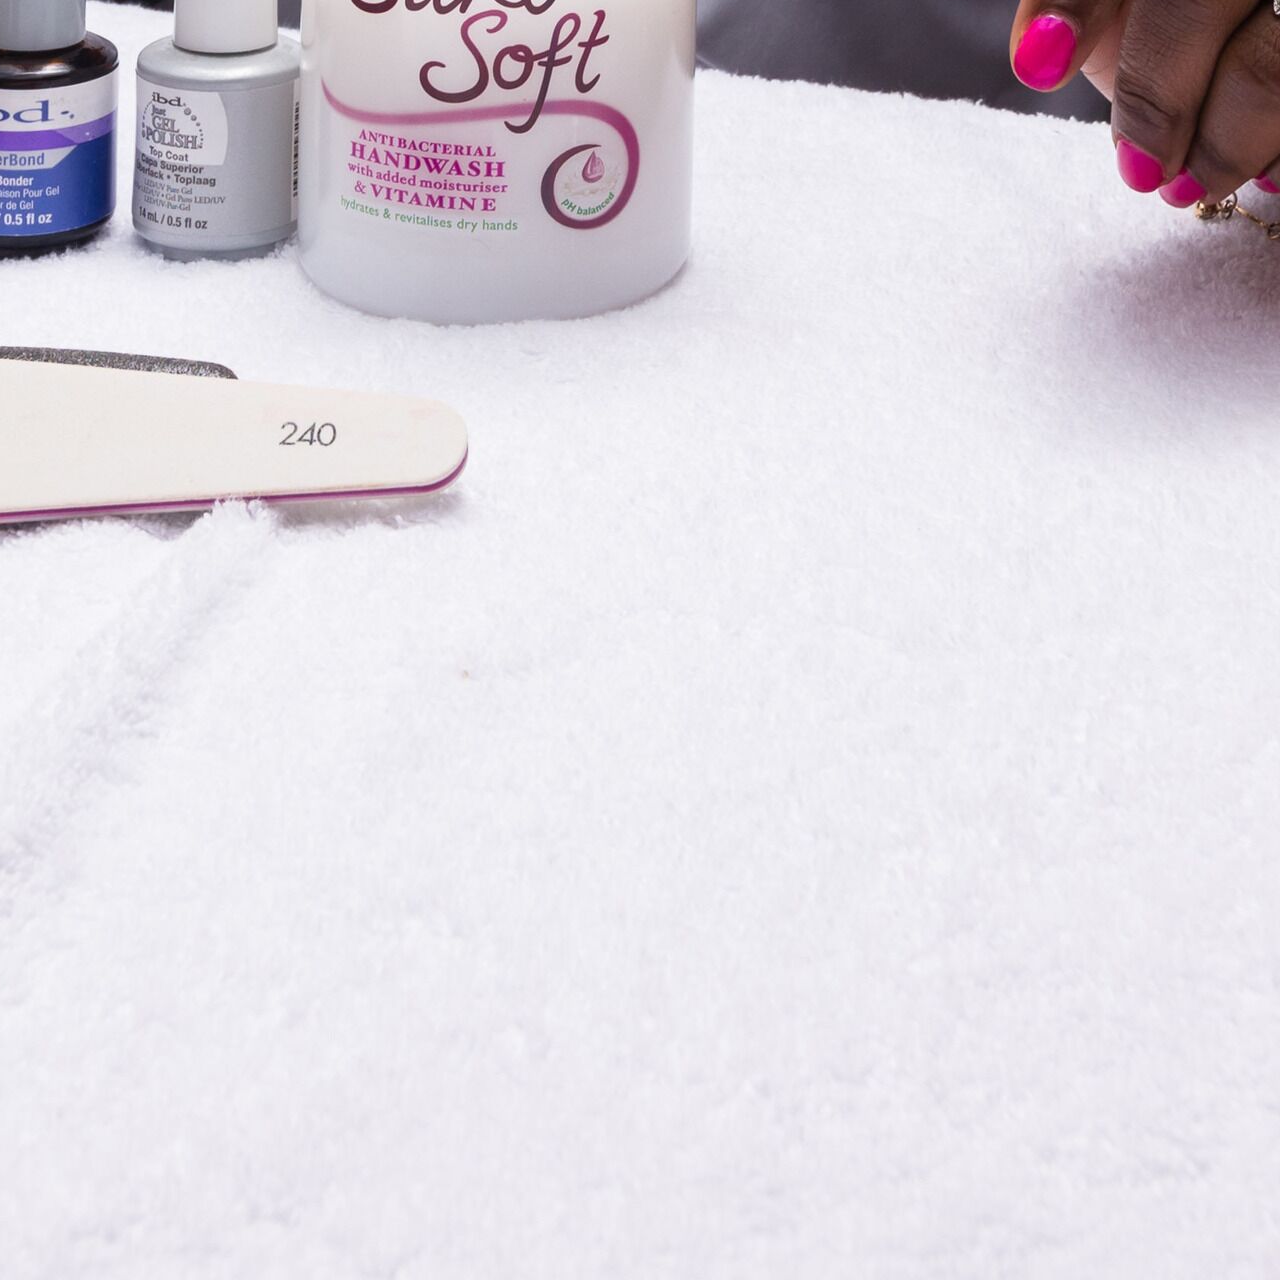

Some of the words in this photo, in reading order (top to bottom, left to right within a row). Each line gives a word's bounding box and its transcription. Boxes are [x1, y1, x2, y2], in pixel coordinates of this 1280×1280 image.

[420, 9, 610, 134] Soft
[152, 116, 180, 133] GEL
[146, 126, 198, 149] POLISH
[149, 146, 163, 158] Top
[166, 151, 188, 161] Coat
[350, 141, 506, 177] HANDWASH
[160, 160, 204, 174] Superior
[174, 174, 216, 187] Toplaag
[348, 162, 373, 177] with
[376, 170, 416, 186] added
[419, 179, 508, 193] moisturiser
[23, 188, 43, 198] Pour
[46, 186, 60, 195] Gel
[354, 180, 366, 194] &
[6, 201, 17, 210] de
[19, 200, 34, 210] Gel
[194, 196, 226, 204] LED/UV
[561, 199, 577, 212] pH
[577, 192, 615, 216] balanced
[4, 214, 23, 225] 0.5
[26, 213, 35, 224] fl
[38, 214, 53, 223] oz
[139, 206, 146, 218] 14
[147, 211, 158, 223] mL
[167, 215, 182, 227] 0.5
[185, 217, 191, 228] fl
[194, 220, 208, 229] oz
[340, 195, 379, 217] hydrates
[383, 208, 391, 219] &
[395, 212, 452, 228] revitalises
[456, 219, 478, 232] dry
[482, 220, 518, 231] hands
[279, 422, 337, 446] 240
